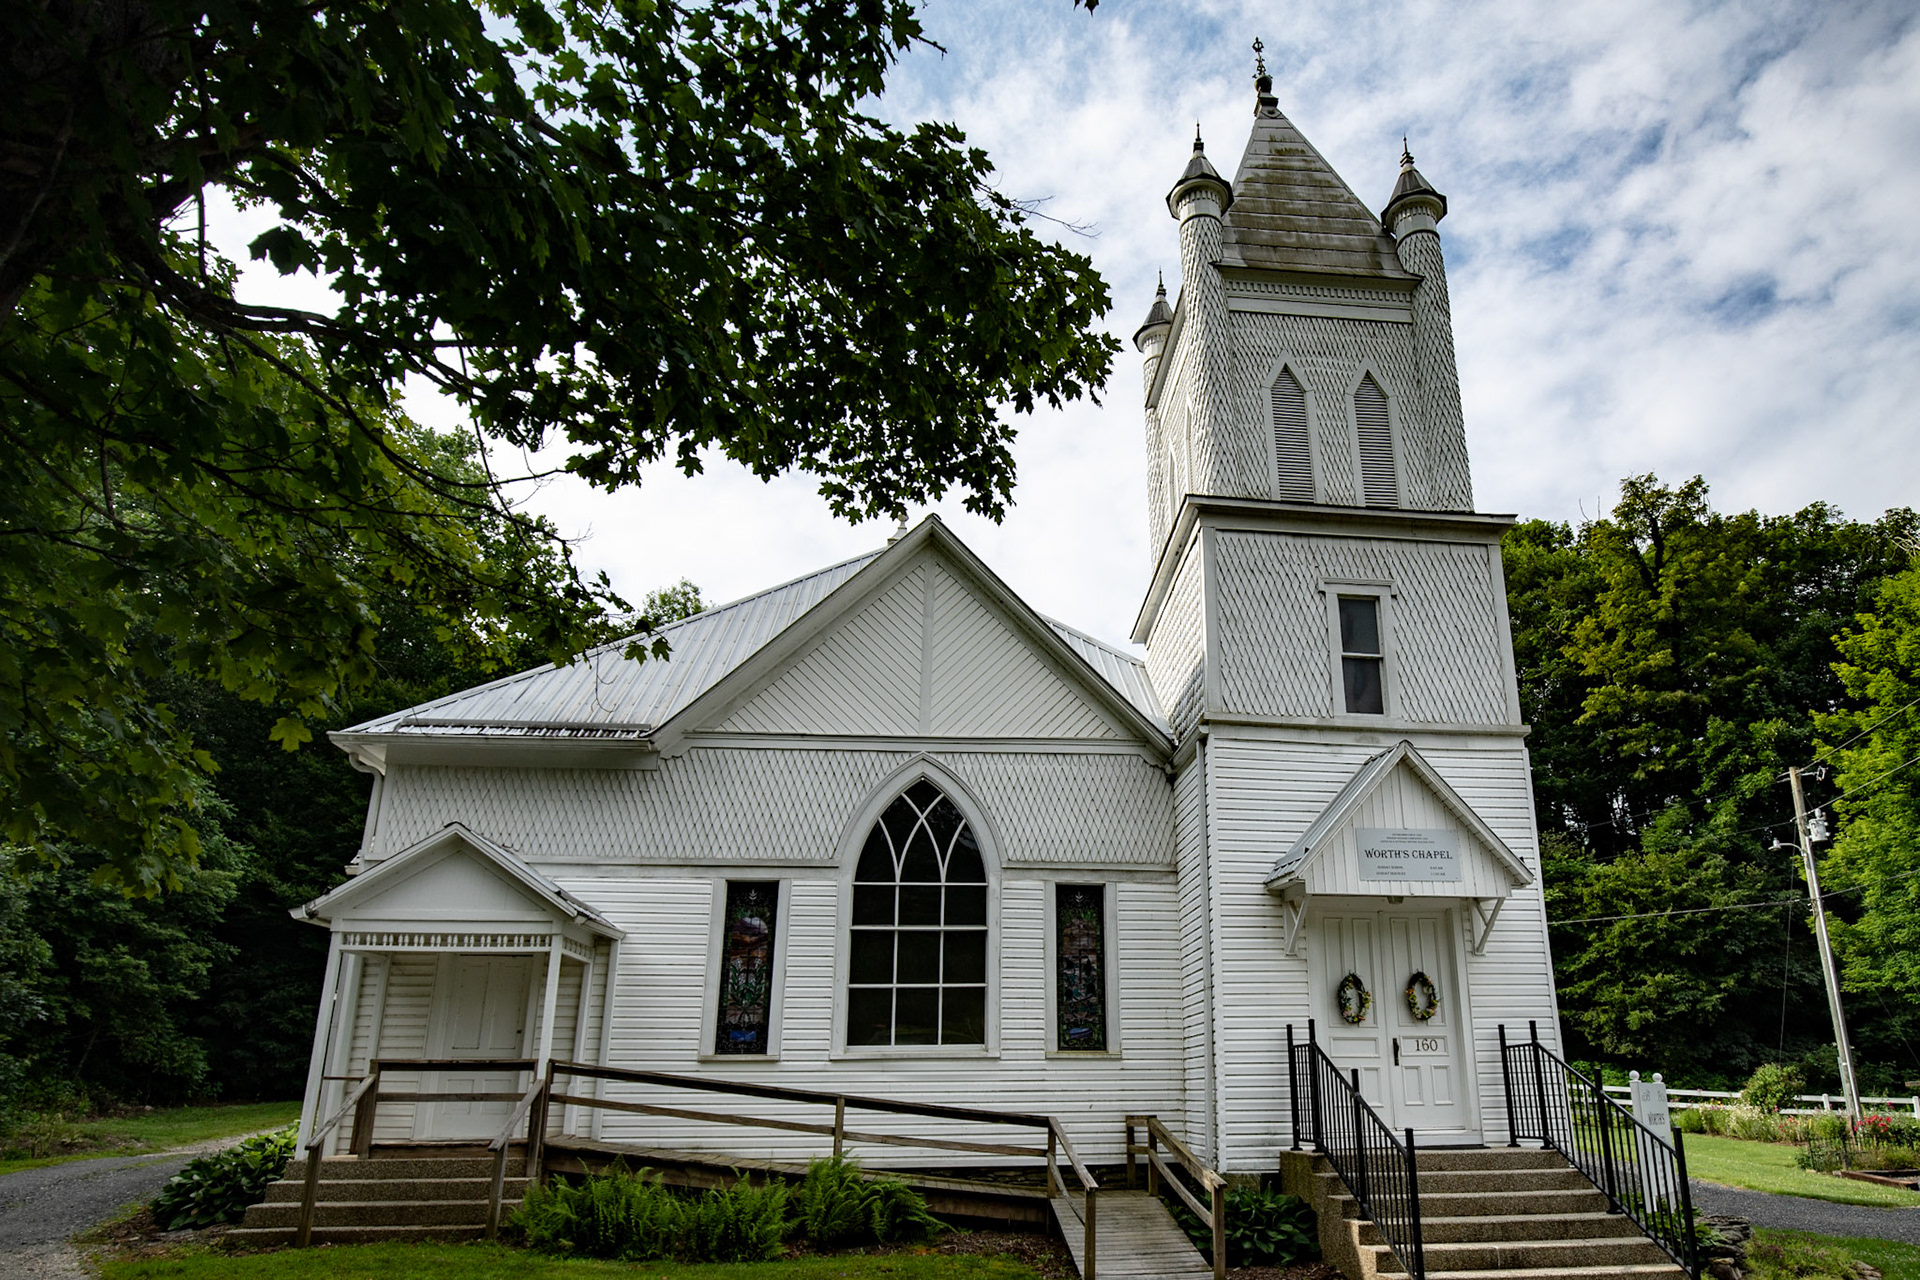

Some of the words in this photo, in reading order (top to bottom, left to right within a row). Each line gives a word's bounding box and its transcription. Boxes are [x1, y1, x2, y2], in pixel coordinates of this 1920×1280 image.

[1364, 848, 1410, 859] WORTH'S
[1411, 850, 1453, 860] CHAPEL
[1415, 1038, 1438, 1052] 160
